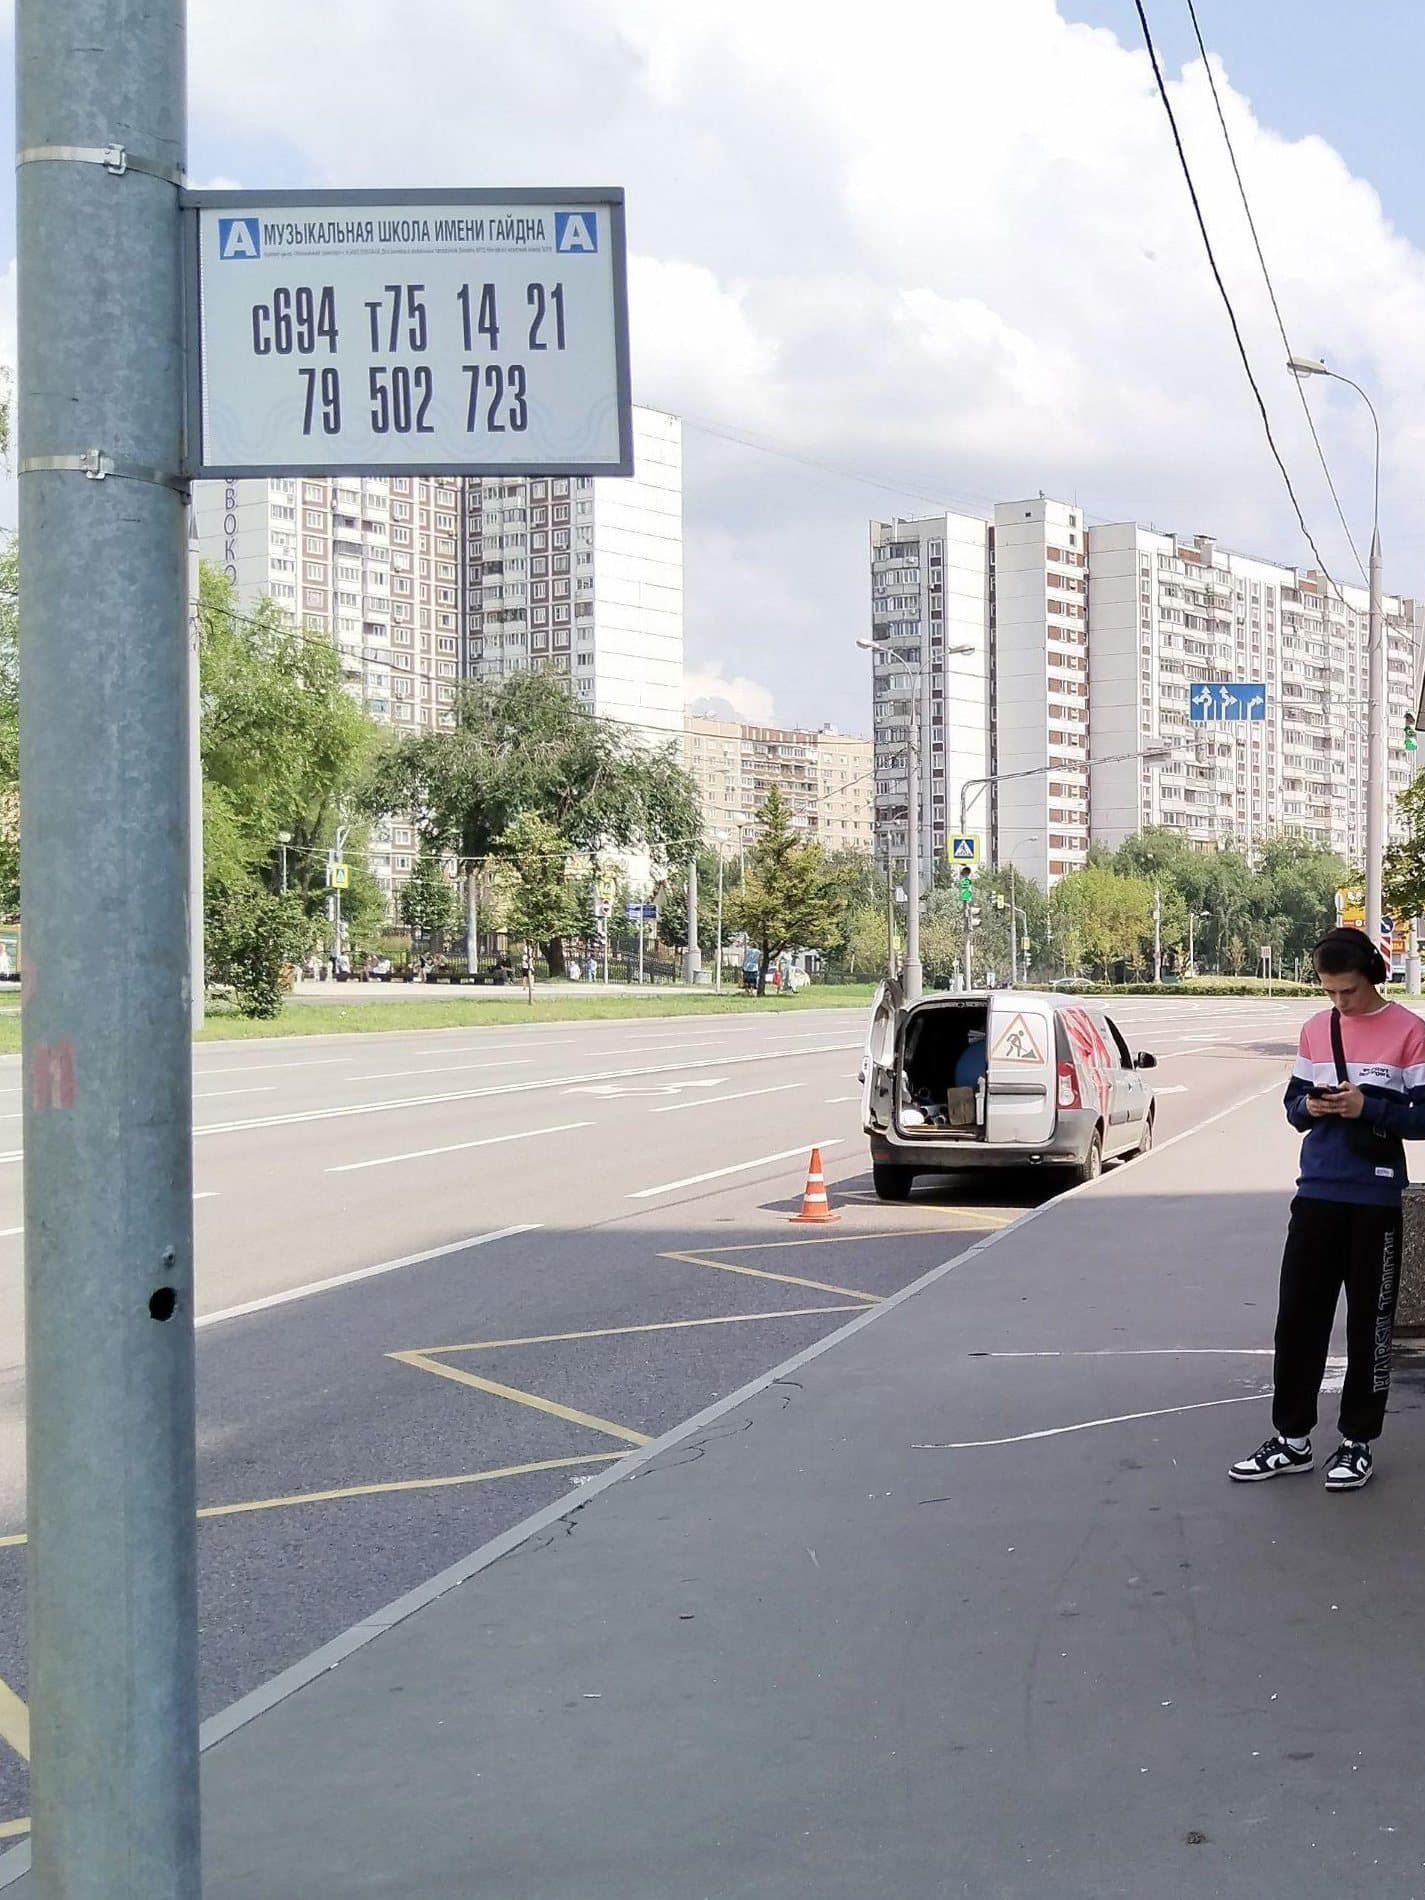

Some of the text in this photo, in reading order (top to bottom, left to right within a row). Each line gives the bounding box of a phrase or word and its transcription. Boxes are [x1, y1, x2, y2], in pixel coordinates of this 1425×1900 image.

[263, 213, 546, 246] МУЗЫКАЛЬНАЯ ШКОЛА ИМЕНИ ГАЙДНА
[252, 282, 566, 355] с694 т75 14 21
[298, 364, 528, 435] 79 502 723
